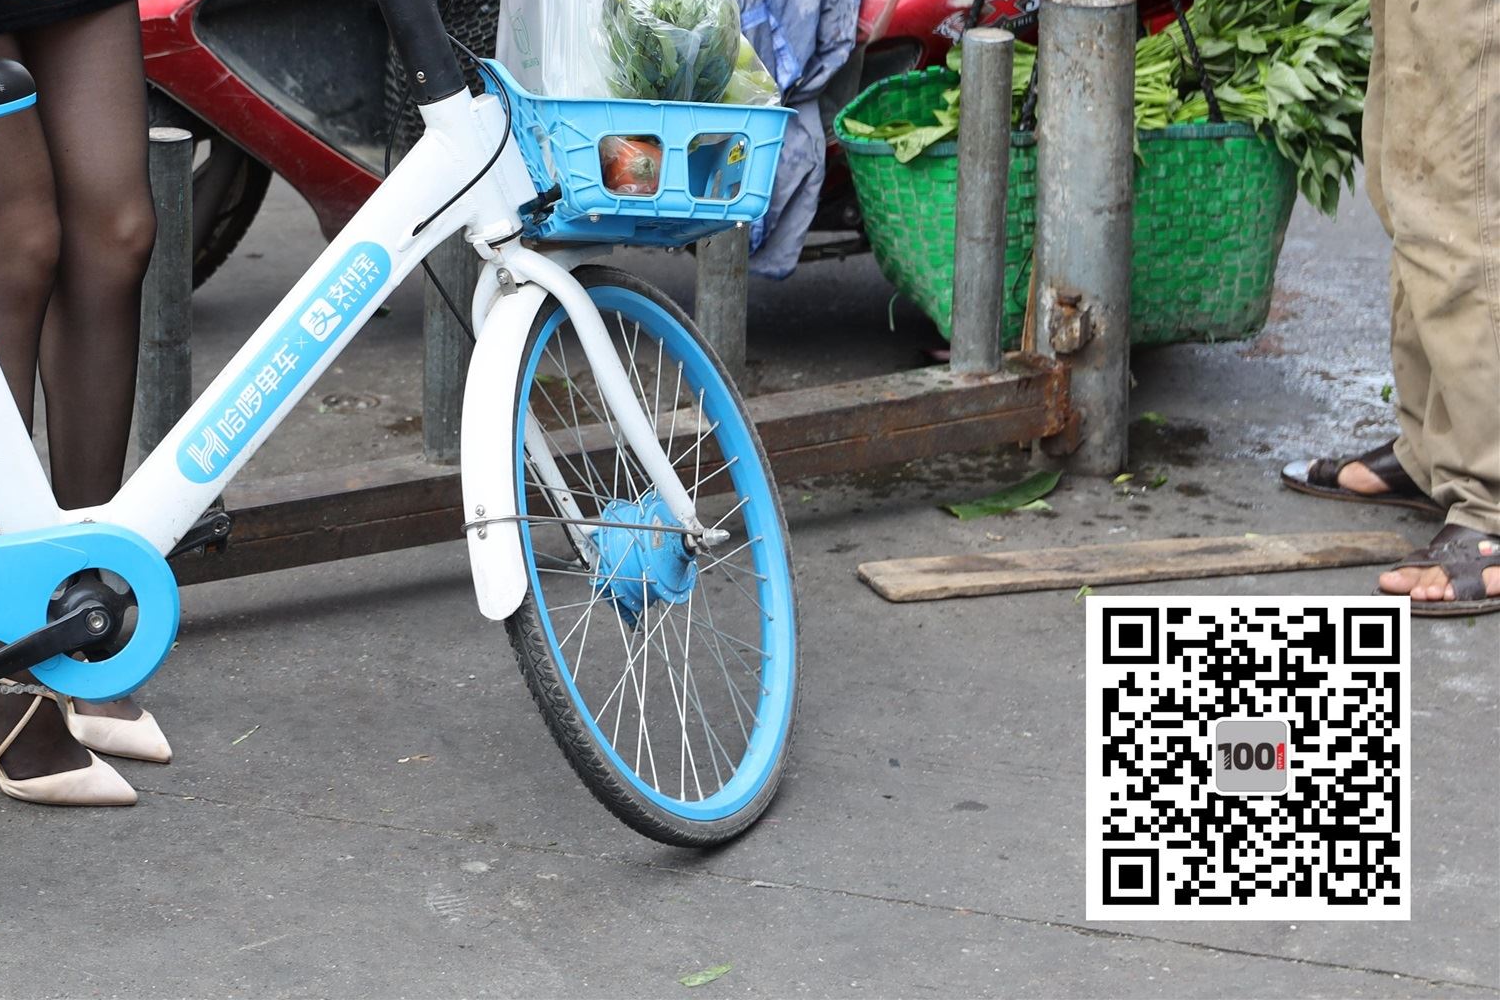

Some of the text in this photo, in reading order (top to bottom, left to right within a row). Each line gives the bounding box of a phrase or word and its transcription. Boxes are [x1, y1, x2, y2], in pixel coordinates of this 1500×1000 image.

[326, 252, 375, 306] 支付宝
[342, 266, 380, 311] ALIPAY
